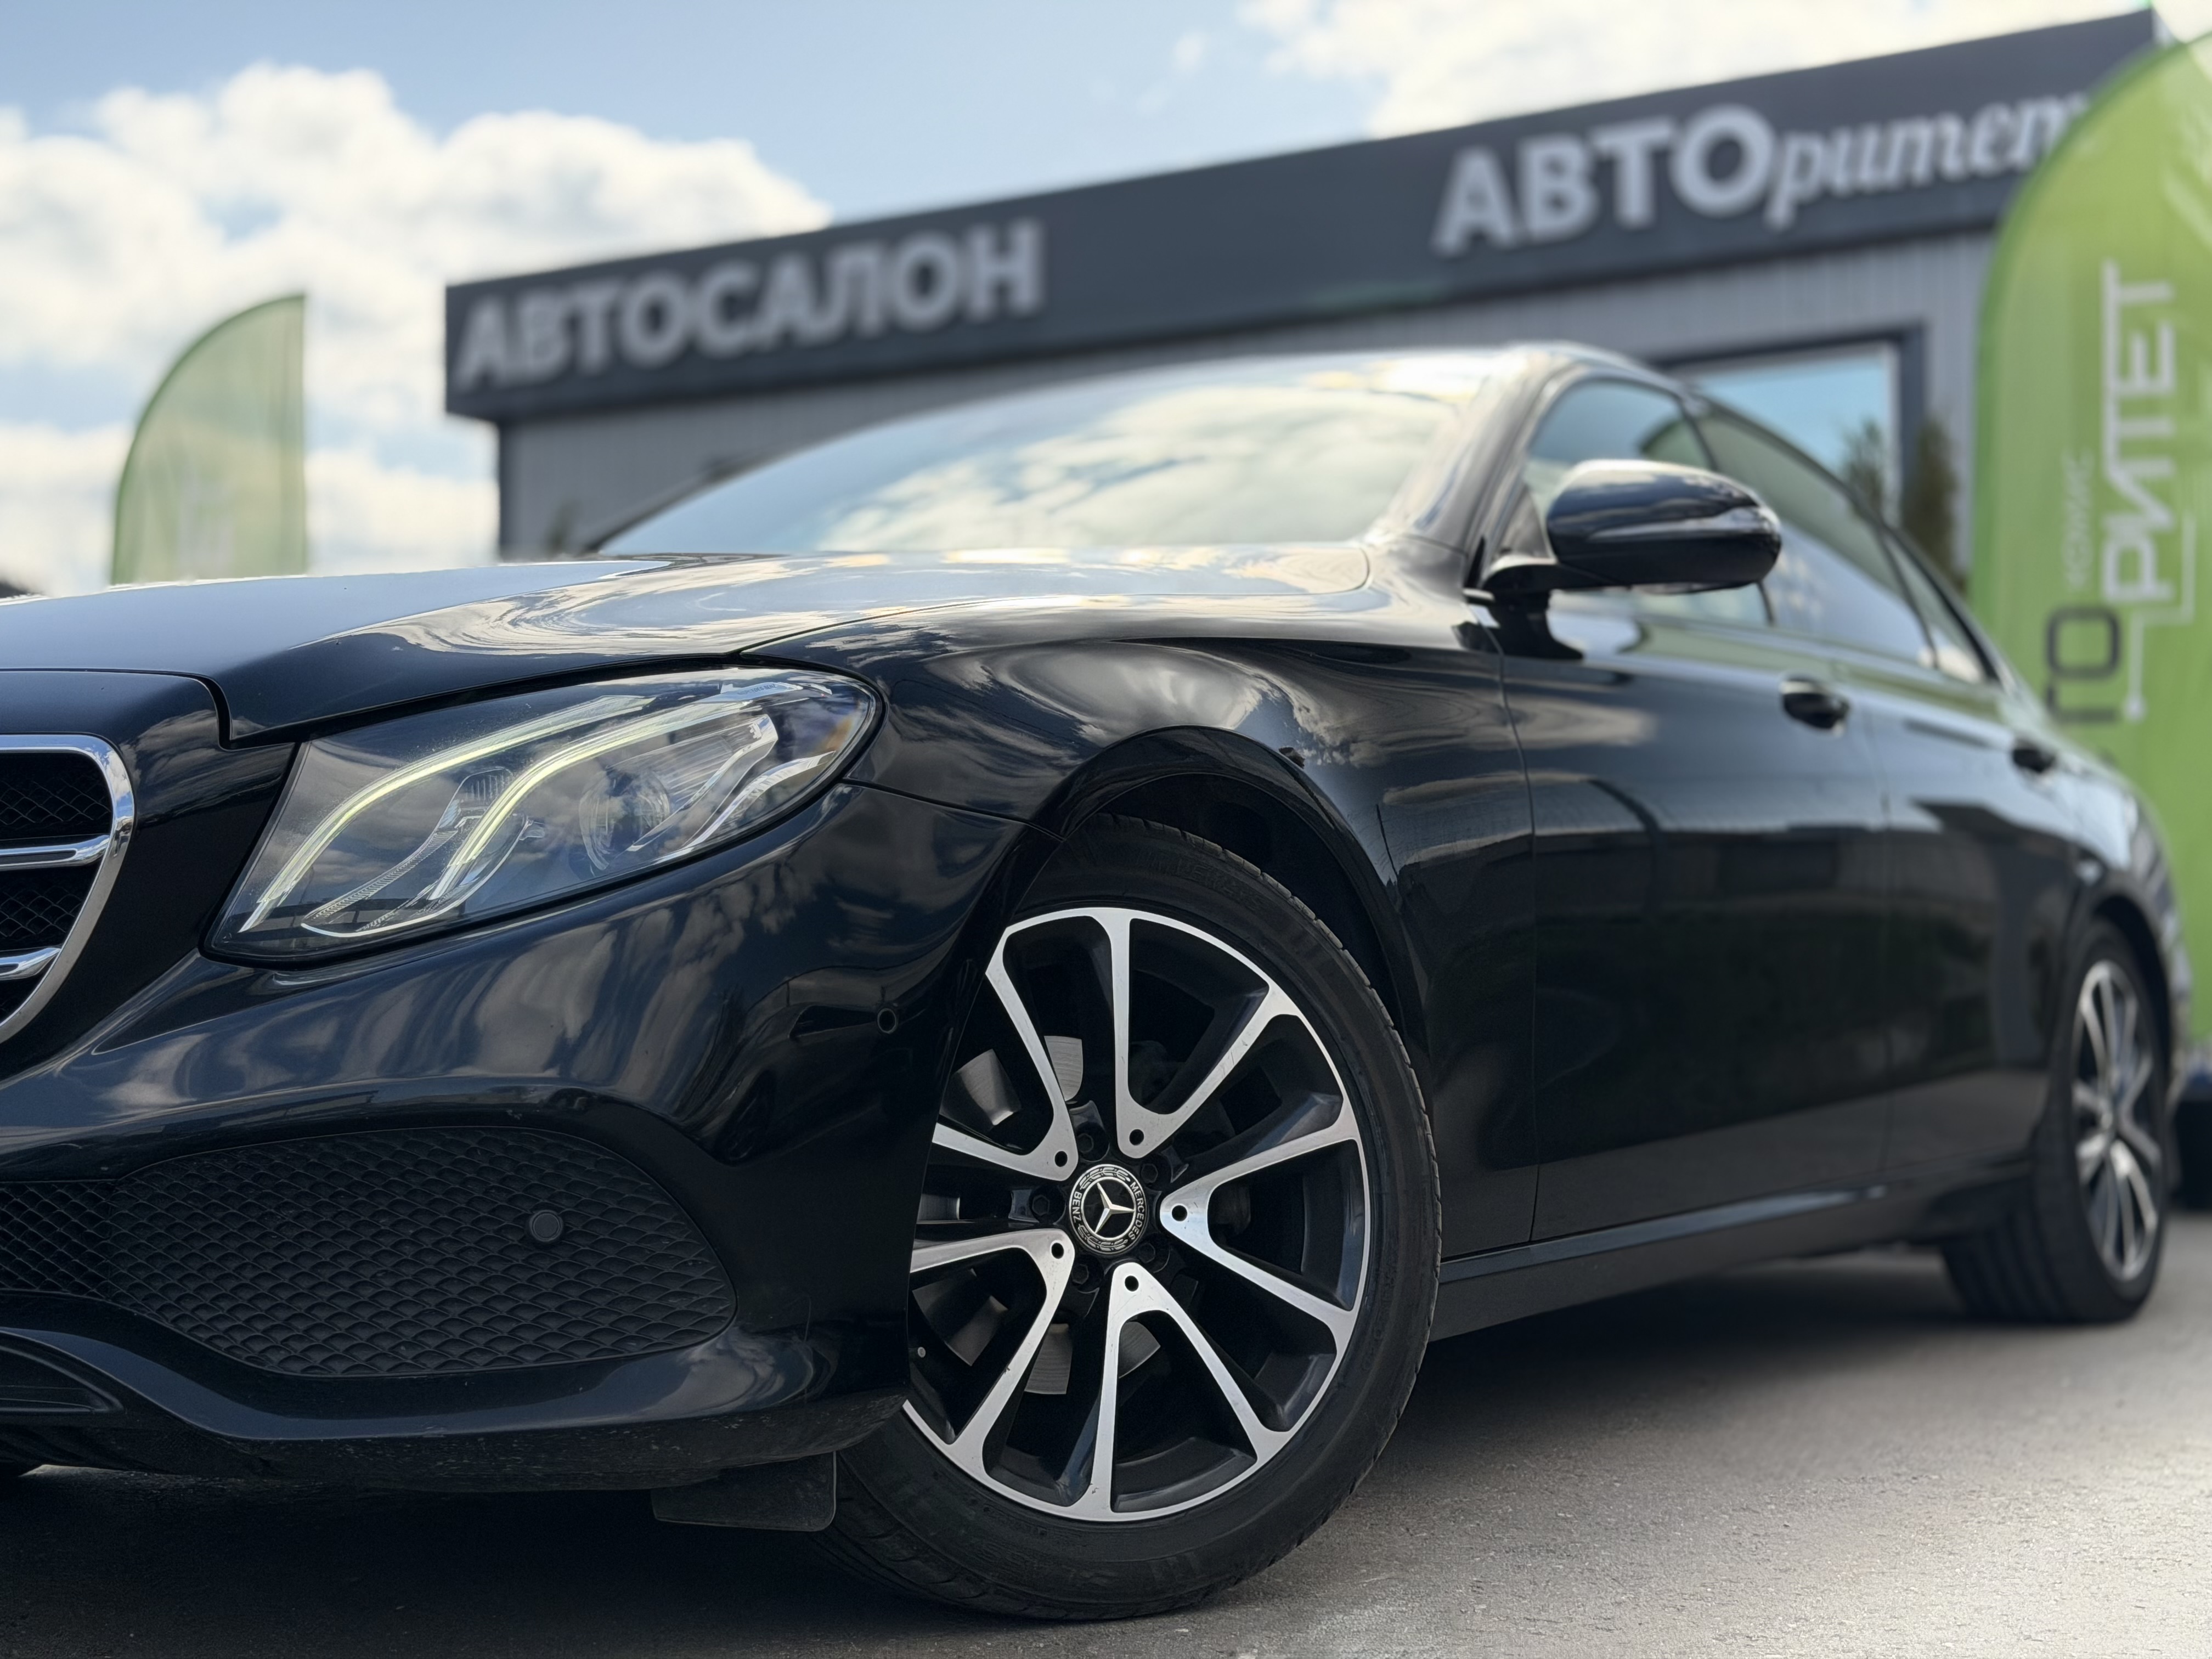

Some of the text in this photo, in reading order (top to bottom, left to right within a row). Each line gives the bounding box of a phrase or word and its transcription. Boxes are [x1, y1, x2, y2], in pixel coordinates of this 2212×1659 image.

[456, 222, 1043, 394] АВТОСАЛОН
[1072, 1191, 1082, 1223] BENZ
[1129, 1182, 1145, 1240] MERCEDES
